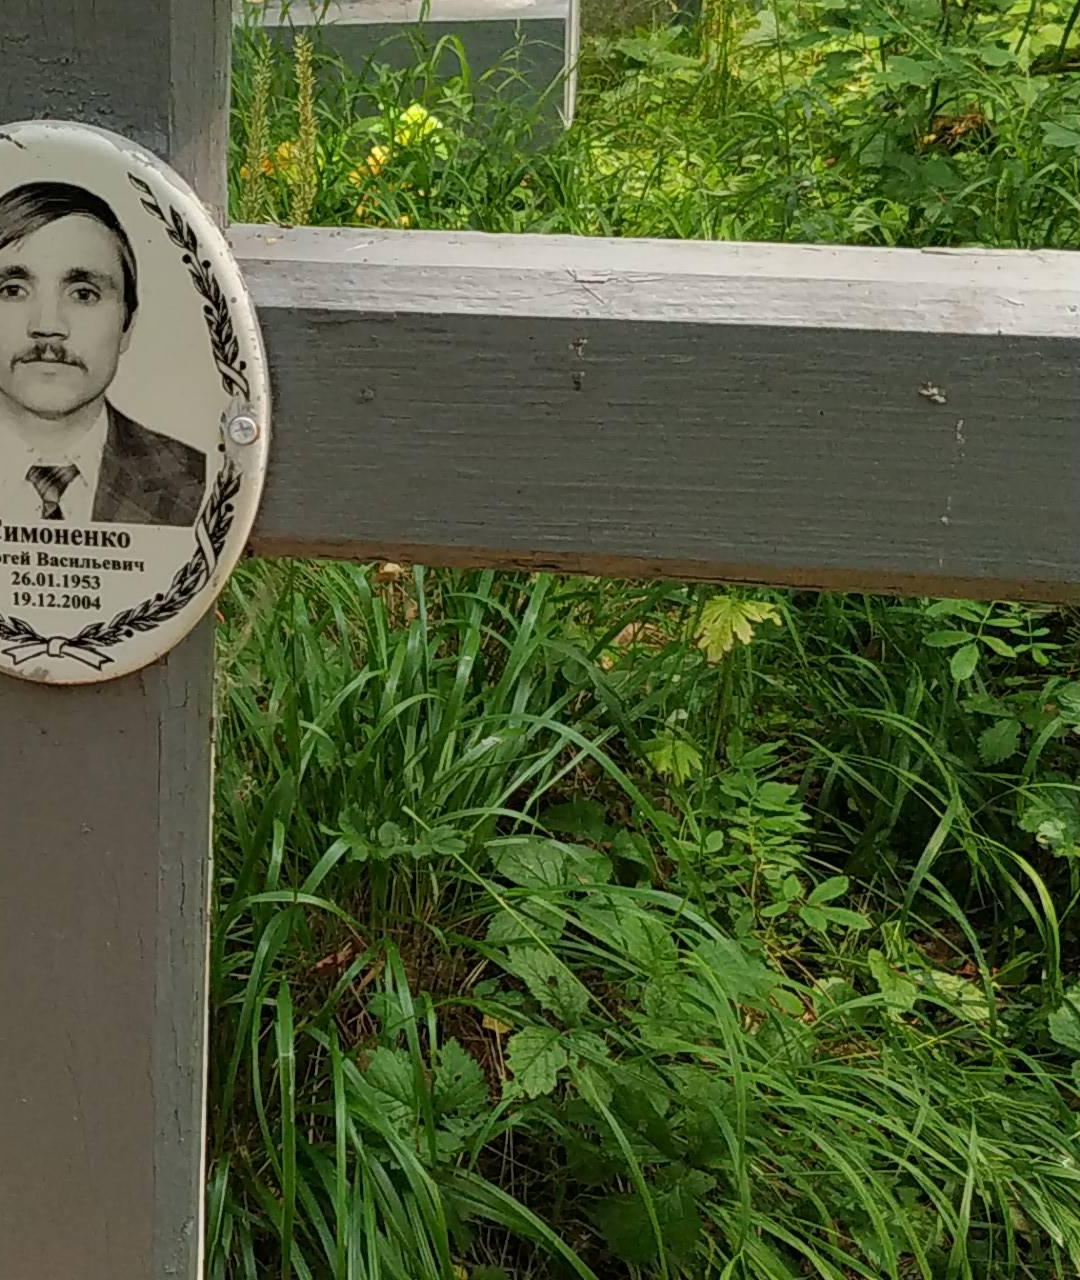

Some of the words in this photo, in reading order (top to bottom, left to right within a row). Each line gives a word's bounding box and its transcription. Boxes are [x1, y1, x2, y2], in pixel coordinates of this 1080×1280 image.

[36, 551, 145, 572] Васильевич
[11, 571, 101, 590] 26.01.1953
[13, 591, 102, 610] 19.12.2004
